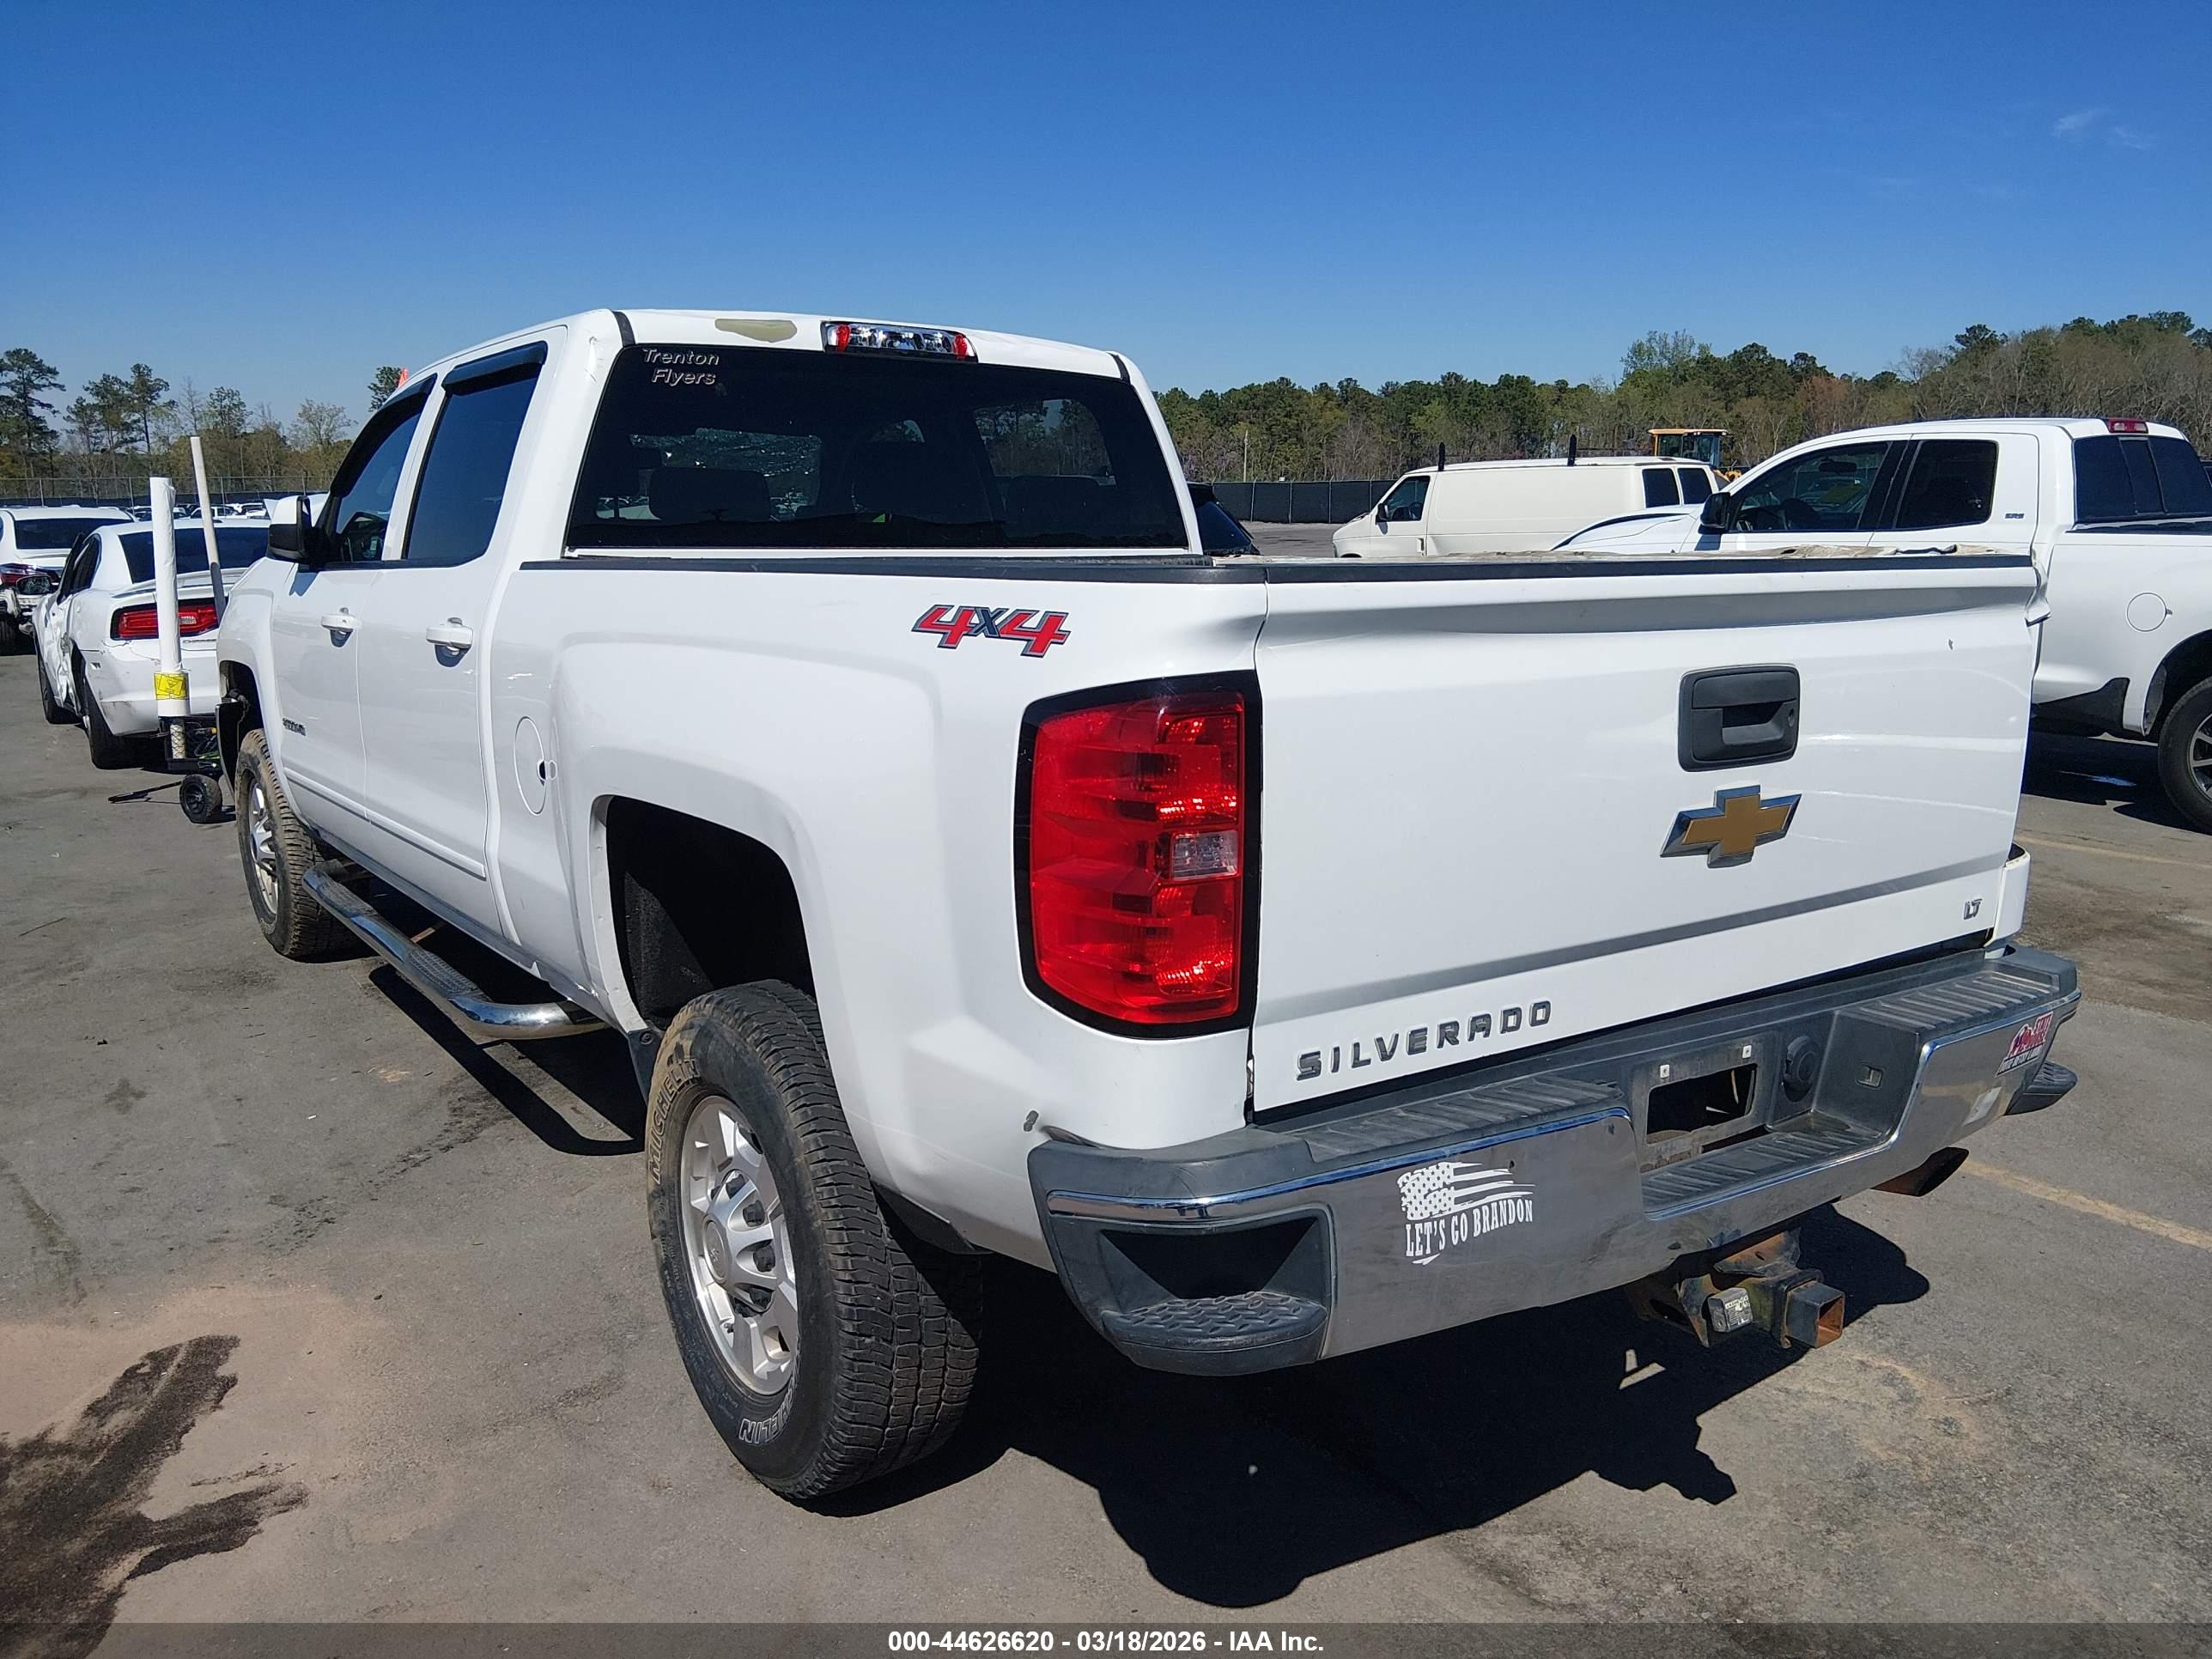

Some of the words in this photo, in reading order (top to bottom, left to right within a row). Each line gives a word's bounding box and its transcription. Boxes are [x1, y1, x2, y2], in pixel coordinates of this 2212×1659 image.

[642, 348, 720, 366] Trenton
[652, 368, 716, 386] Flyers
[1964, 898, 1983, 920] LT
[1297, 1000, 1551, 1081] SILVERADO
[648, 1058, 701, 1185] MICHELIN
[1406, 1218, 1445, 1257] LET'S
[1451, 1212, 1468, 1245] GO
[1473, 1198, 1533, 1237] BRANDON
